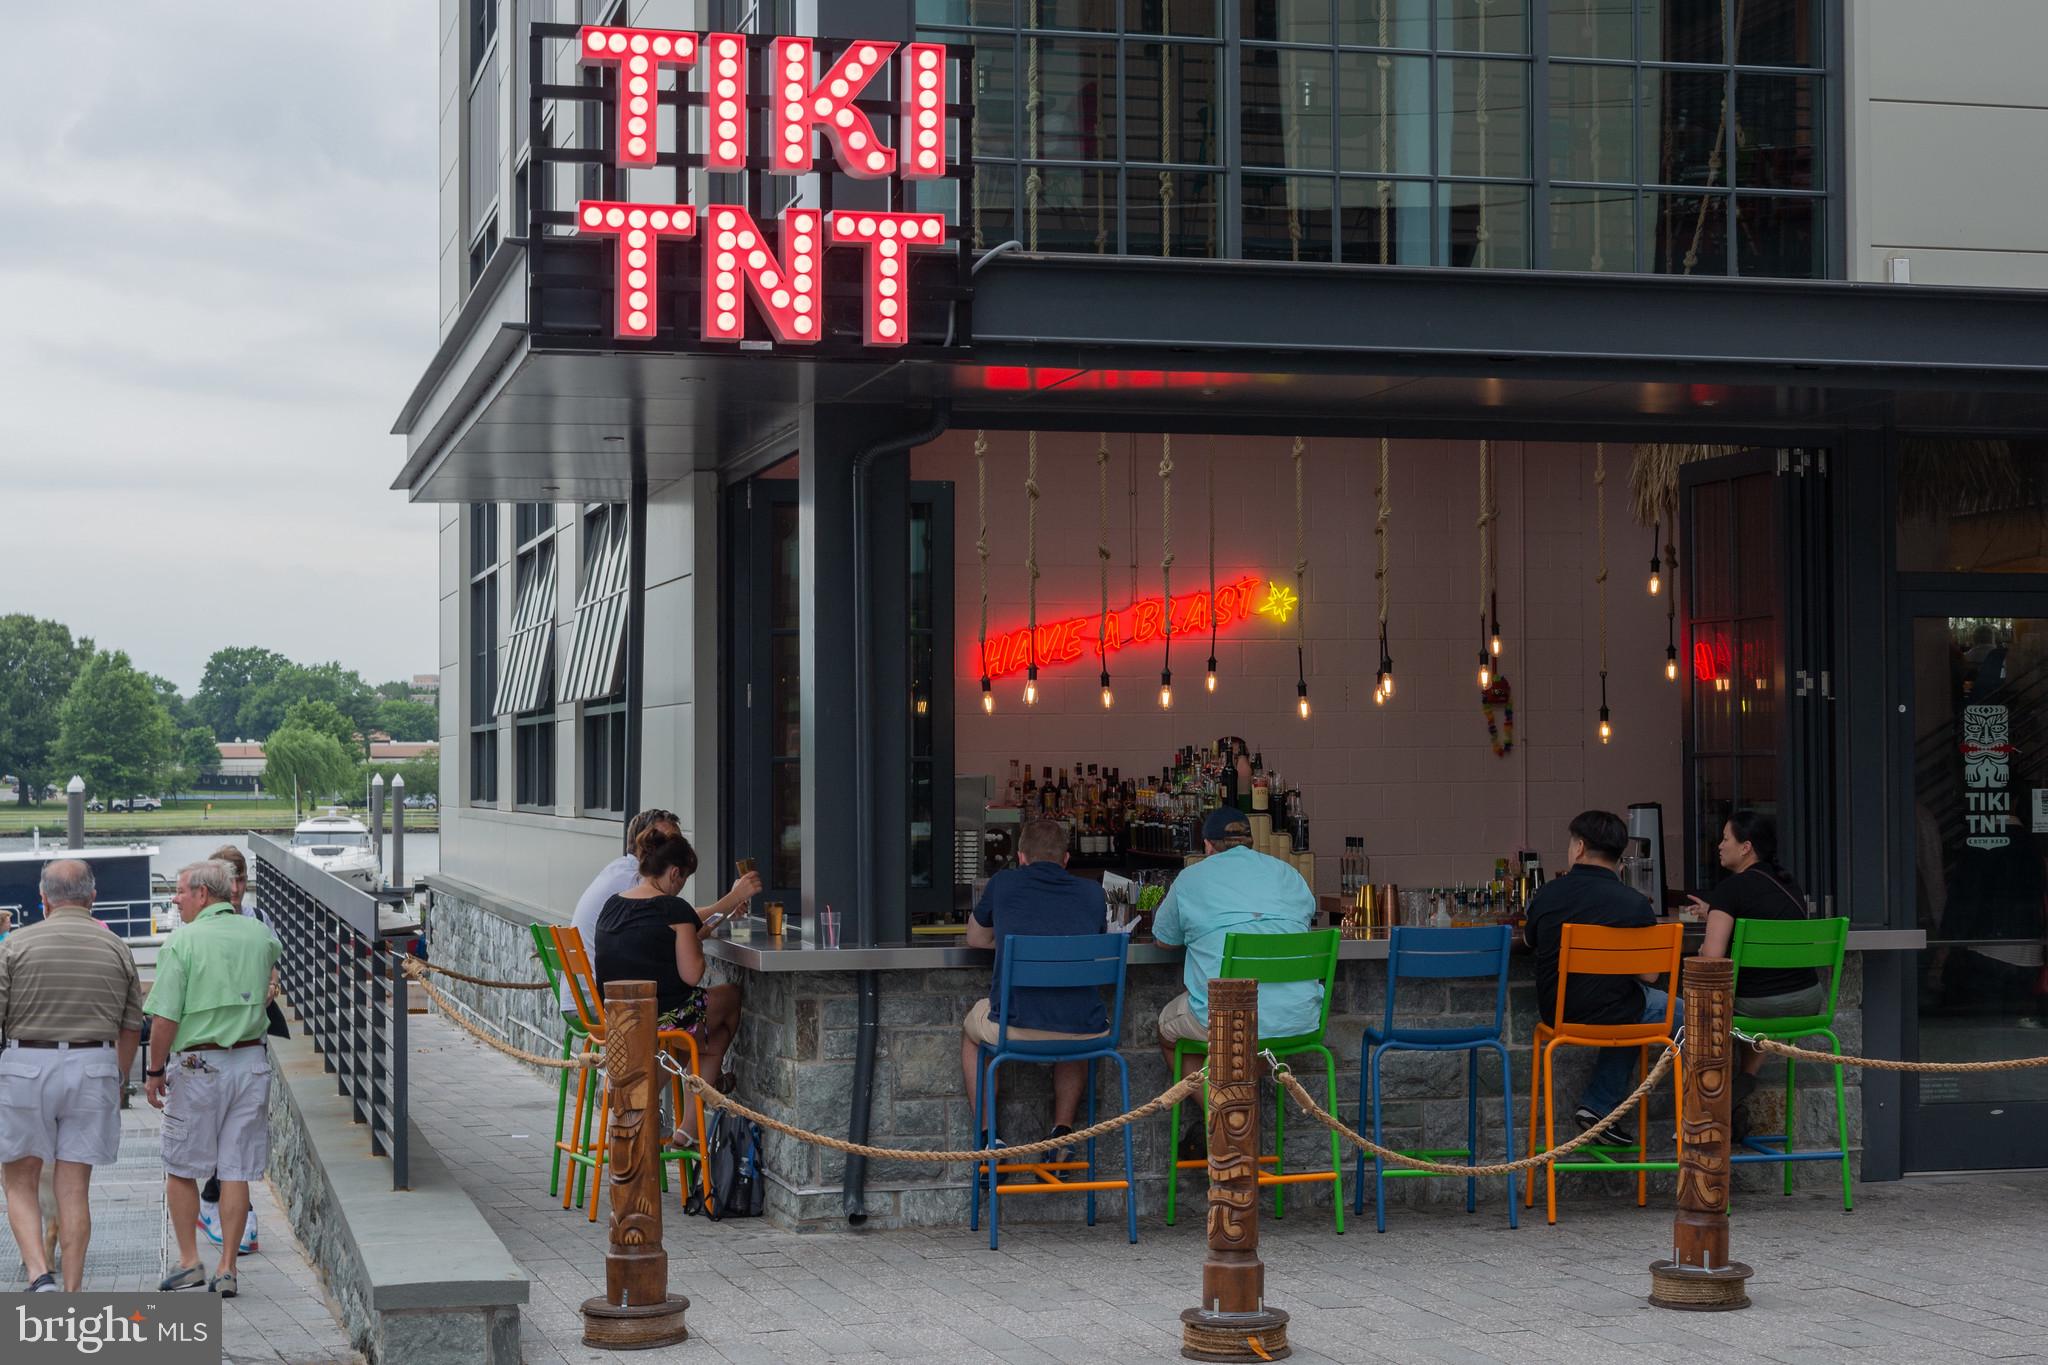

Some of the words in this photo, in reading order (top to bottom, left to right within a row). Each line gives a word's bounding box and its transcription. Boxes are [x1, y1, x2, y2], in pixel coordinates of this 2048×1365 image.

[576, 26, 946, 180] TIKI
[574, 200, 945, 347] TNT
[983, 618, 1088, 678] HAVE
[1096, 613, 1120, 654] A
[1133, 578, 1261, 642] BLAST
[1965, 792, 2010, 811] TIKI
[1965, 815, 2009, 833] TNT
